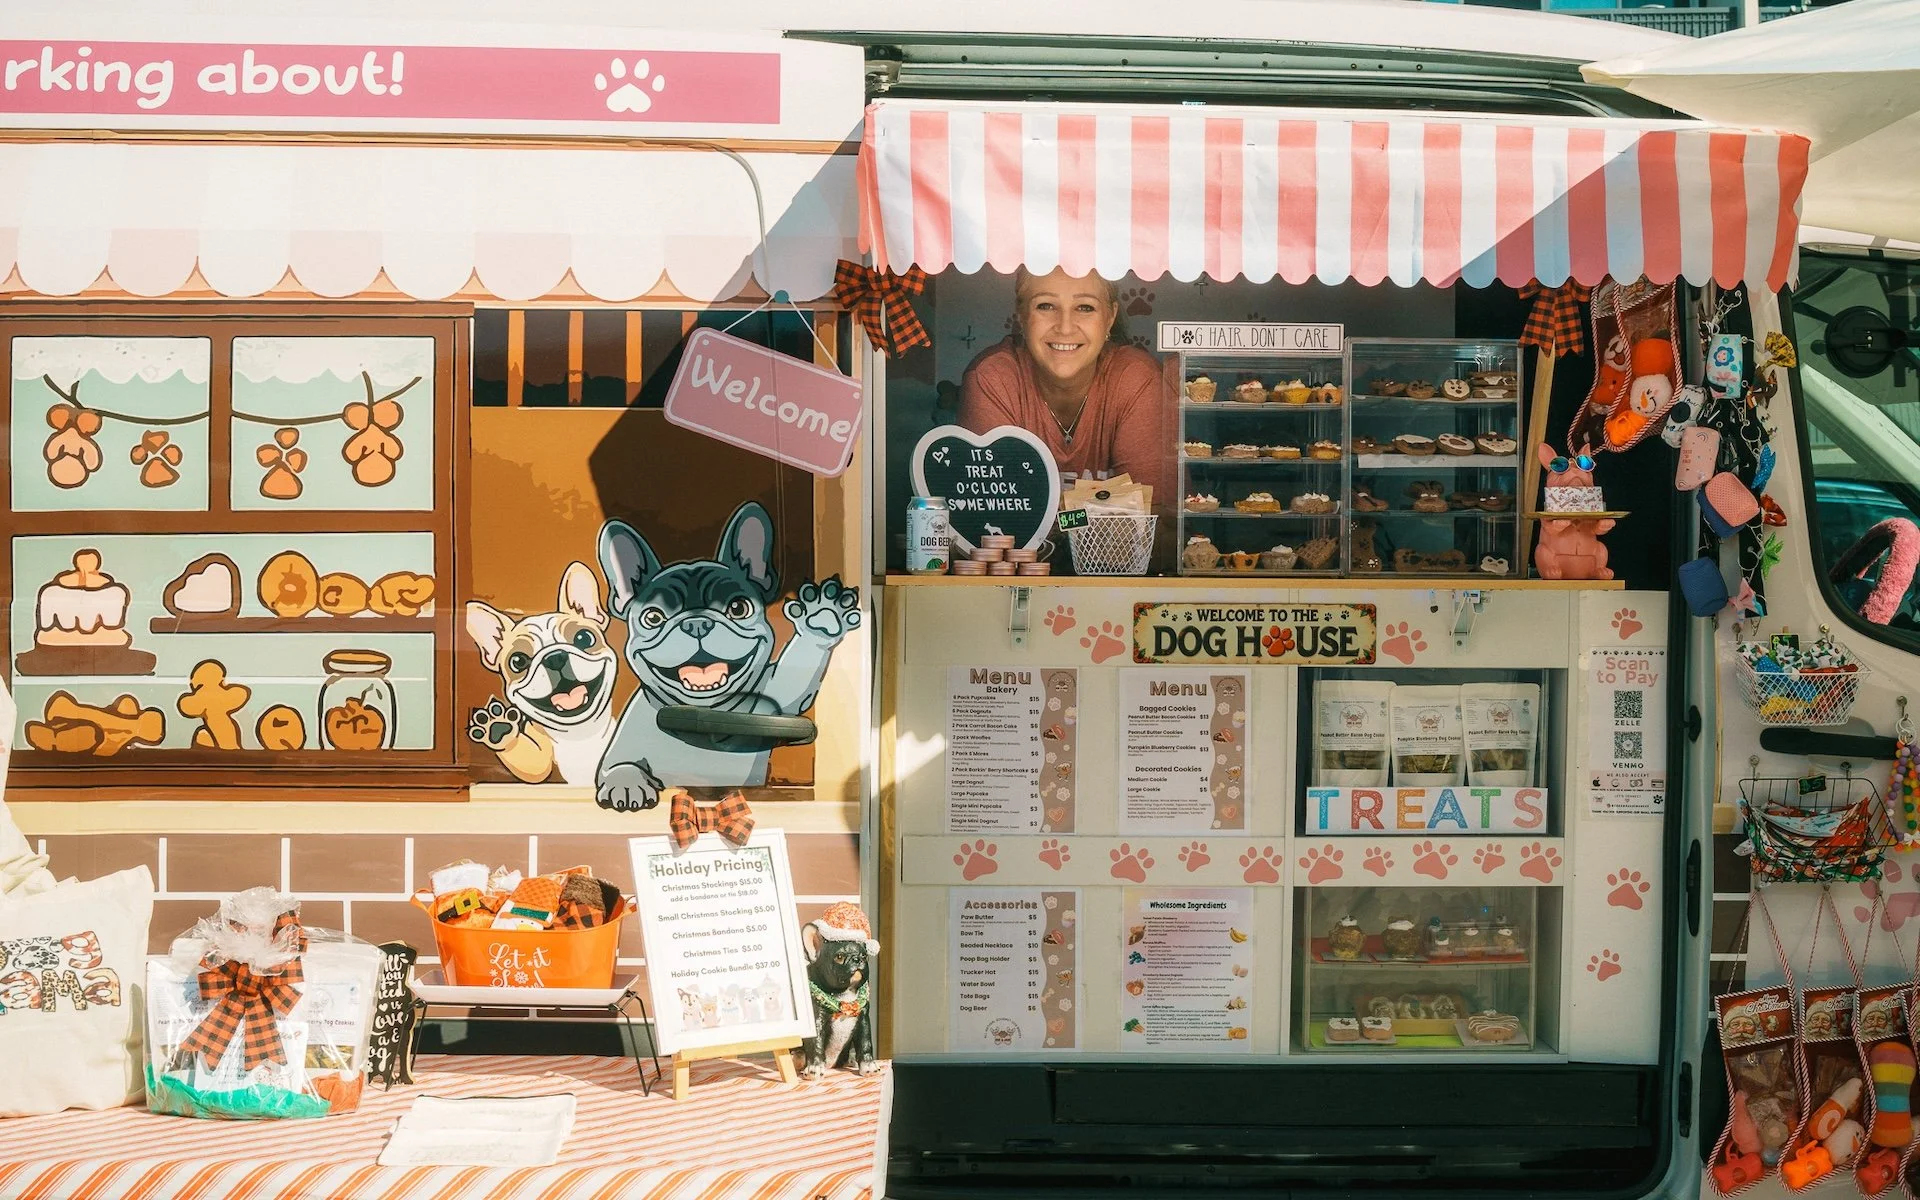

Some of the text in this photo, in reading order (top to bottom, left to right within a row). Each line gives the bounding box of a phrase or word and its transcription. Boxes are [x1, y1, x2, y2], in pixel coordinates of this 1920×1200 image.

[197, 49, 404, 96] about!
[1252, 328, 1287, 348] DON'T
[1295, 328, 1328, 348] CARE
[691, 355, 851, 443] Welcome
[965, 466, 1004, 478] TREAT
[956, 482, 1017, 494] O'CLOCK
[921, 537, 949, 546] DOG BEE
[1197, 609, 1318, 622] WELCOME TO THE
[1153, 625, 1227, 657] DOG
[1605, 658, 1649, 670] Scan
[970, 668, 1031, 684] Menu
[1597, 671, 1658, 687] to Pay
[987, 686, 1017, 695] Bakery
[1150, 681, 1207, 696] Menu
[1309, 789, 1543, 829] TREATS
[655, 859, 763, 876] Holiday Pricing
[662, 884, 700, 892] Christmas
[702, 880, 737, 889] Stockings
[965, 901, 1037, 909] Accessories
[1188, 902, 1226, 911] Ingredients
[658, 905, 775, 922] Small Christmas Stocking $5.00
[672, 931, 710, 939] Christmas
[489, 943, 551, 970] Let it
[683, 950, 721, 958] Christmas
[742, 944, 762, 952] $5.00
[671, 969, 699, 978] Holiday
[701, 966, 727, 974] Cookie
[755, 961, 780, 969] $37.00
